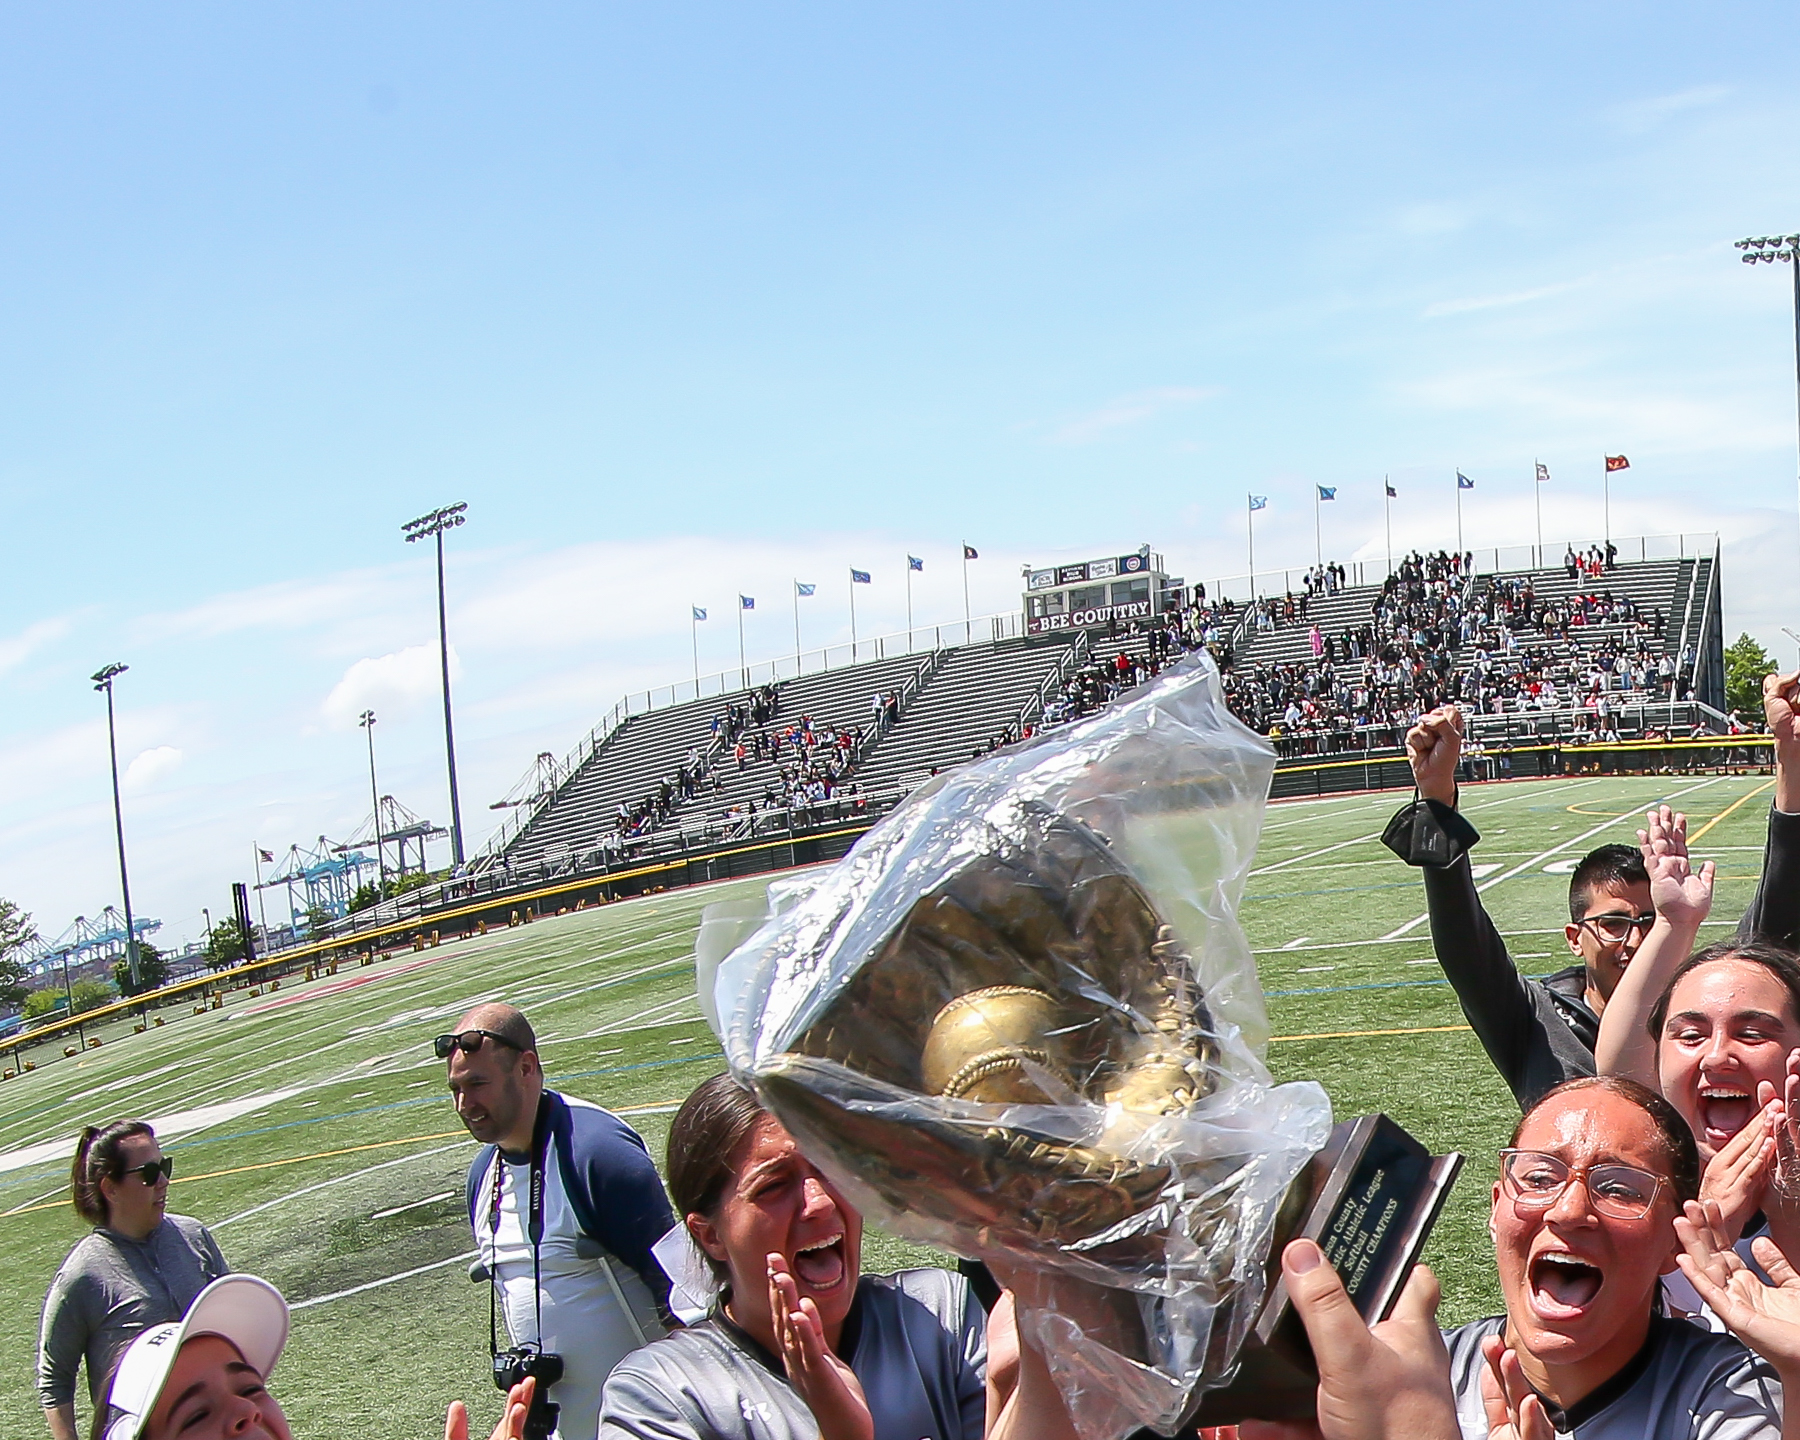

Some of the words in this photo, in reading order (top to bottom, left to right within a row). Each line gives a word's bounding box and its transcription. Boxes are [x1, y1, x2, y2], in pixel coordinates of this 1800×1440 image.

[1040, 613, 1070, 631] BEE
[533, 1169, 542, 1211] Canon
[1342, 1203, 1368, 1246] Athletic
[1361, 1168, 1386, 1205] League
[1333, 1197, 1358, 1234] County
[1344, 1230, 1369, 1272] Softball
[1346, 1254, 1371, 1295] COUNTY
[1366, 1197, 1399, 1254] CHAMPIONS
